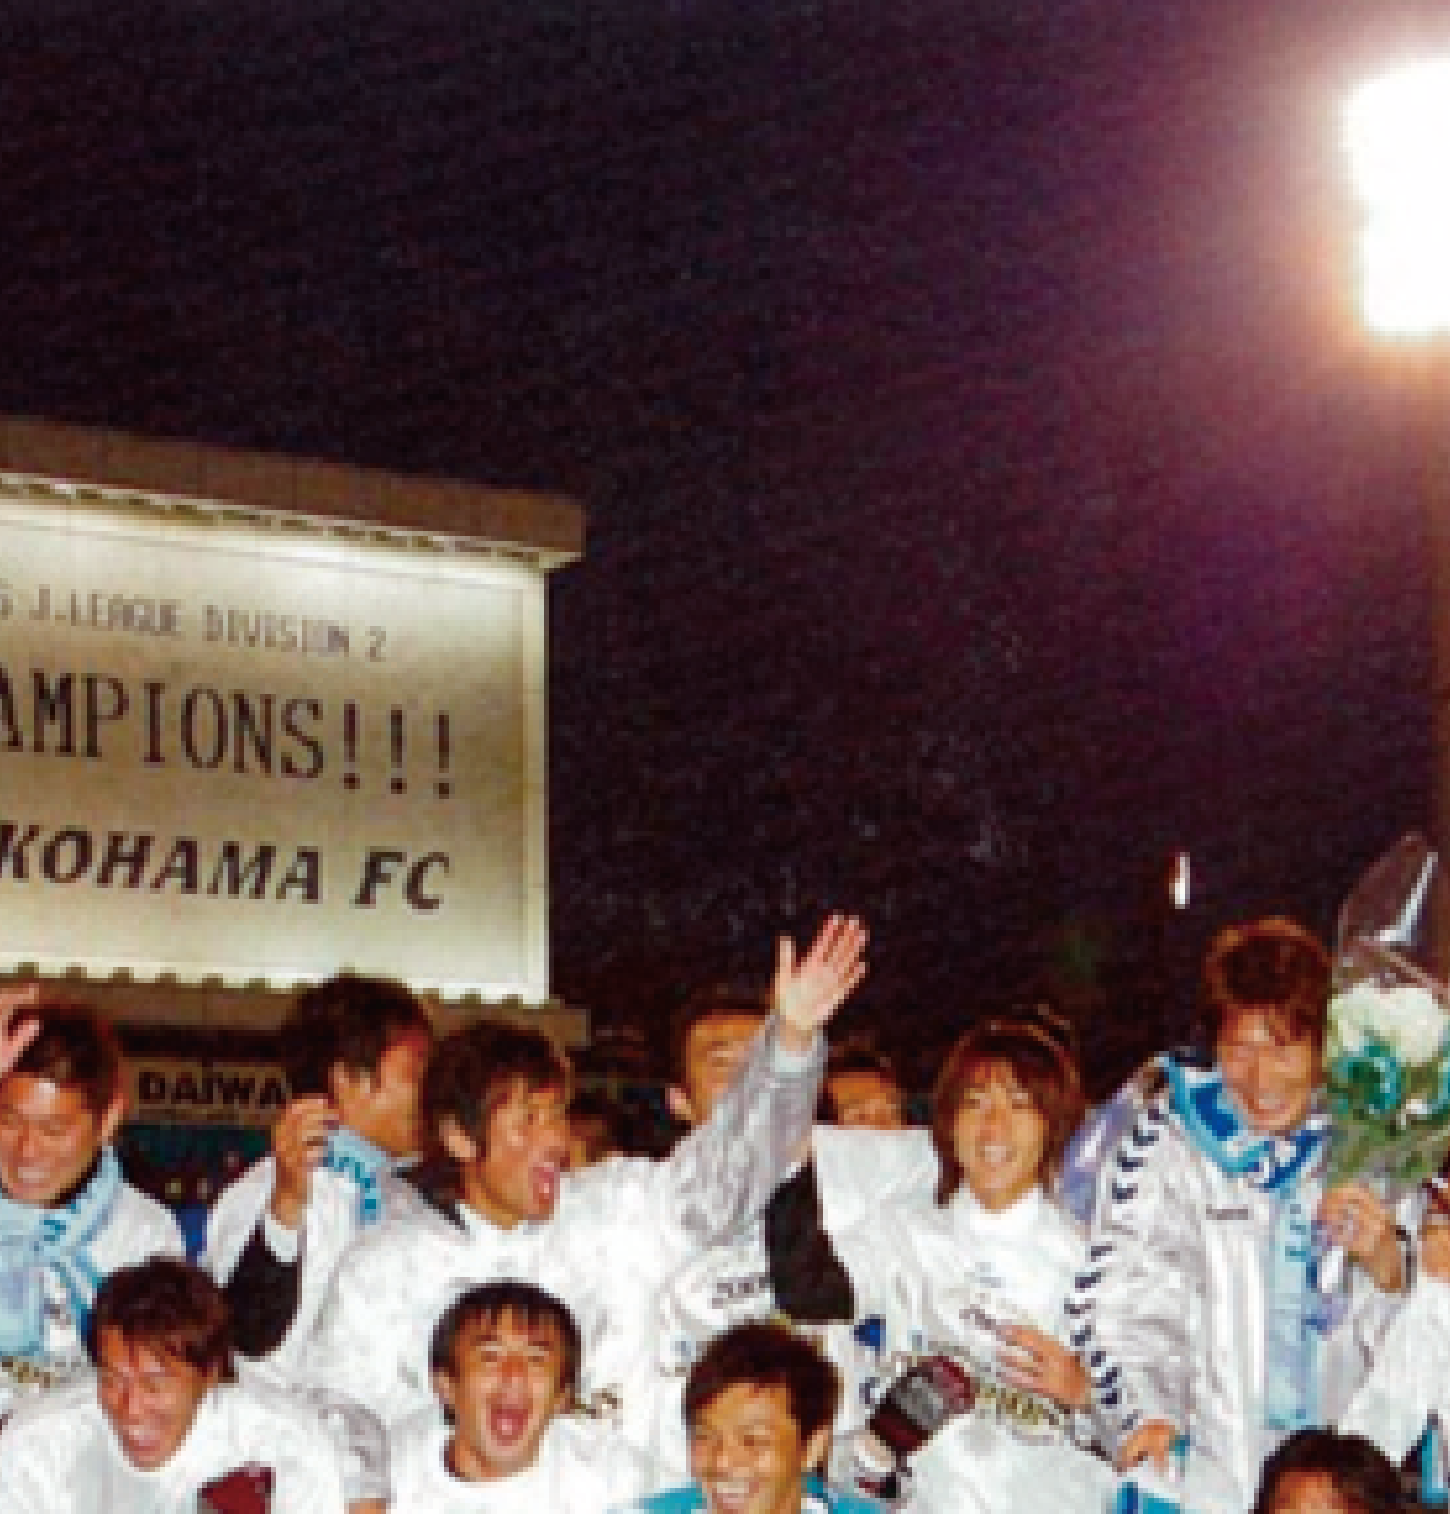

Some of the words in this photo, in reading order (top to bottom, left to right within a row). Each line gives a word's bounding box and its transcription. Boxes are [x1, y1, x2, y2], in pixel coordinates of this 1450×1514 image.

[31, 583, 181, 637] J.LEAGUE
[205, 604, 350, 656] DIVISION
[366, 625, 387, 661] 2
[352, 851, 450, 911] FC
[137, 1070, 289, 1108] DAIWA
